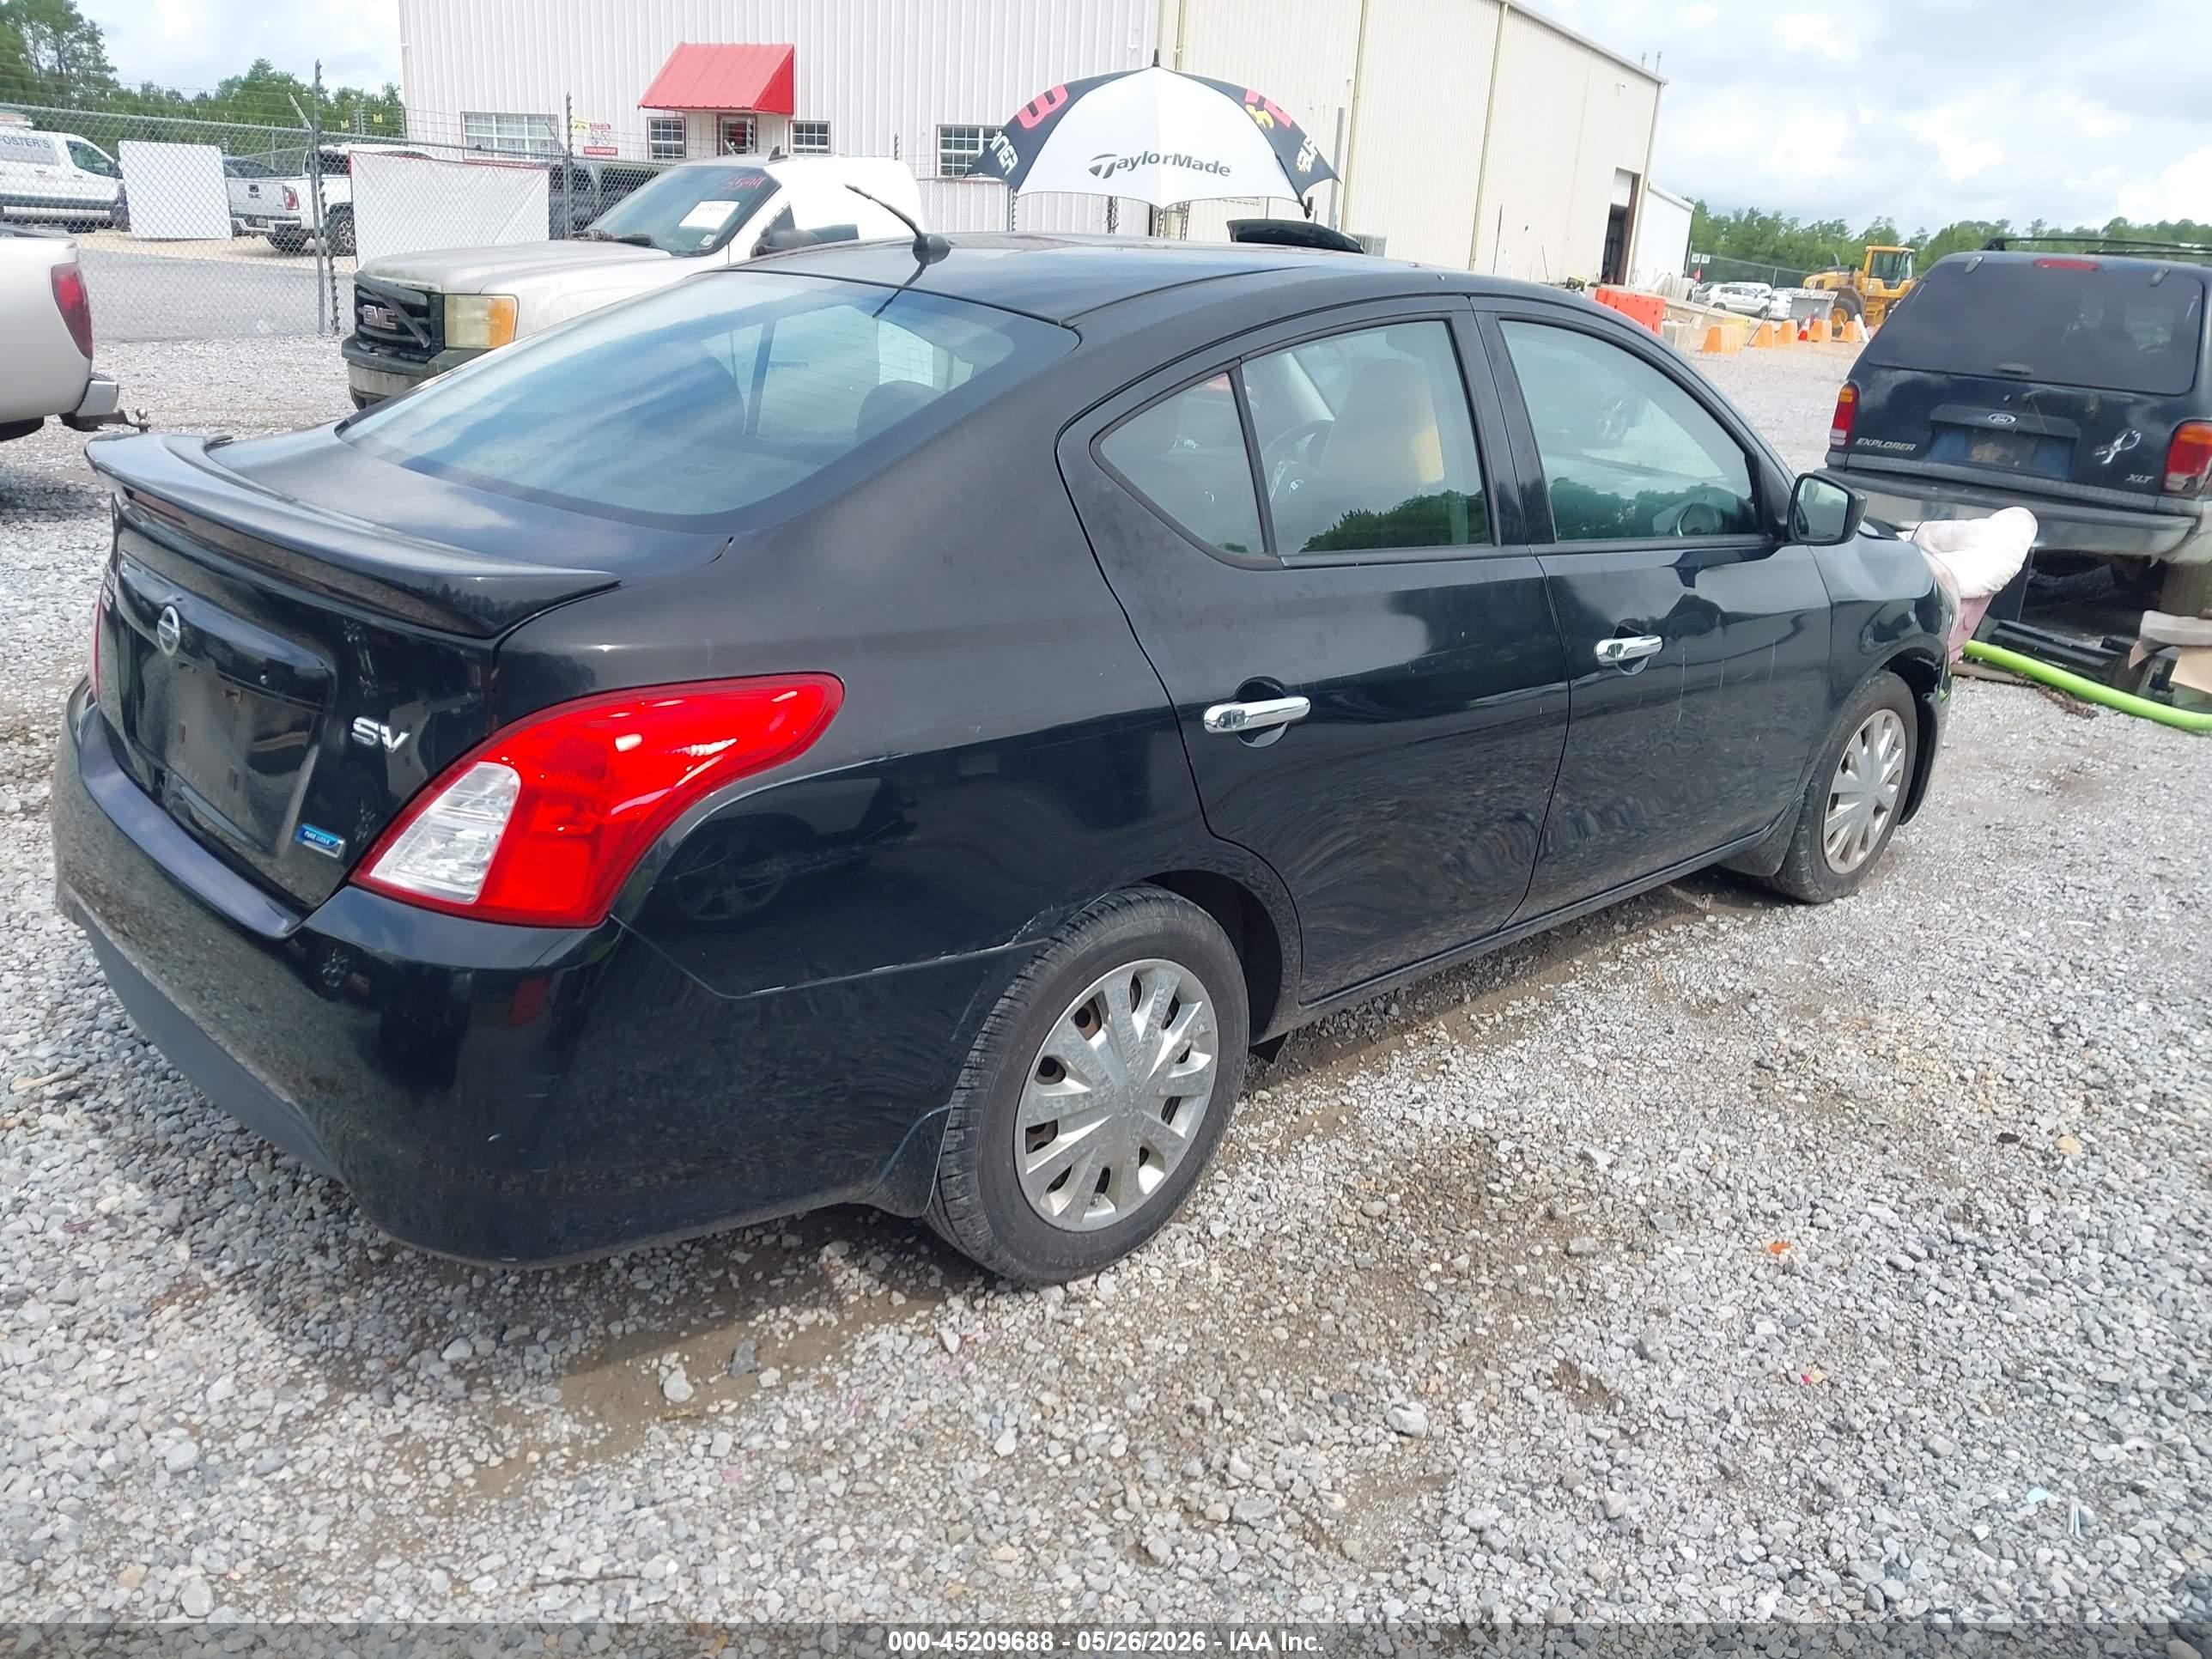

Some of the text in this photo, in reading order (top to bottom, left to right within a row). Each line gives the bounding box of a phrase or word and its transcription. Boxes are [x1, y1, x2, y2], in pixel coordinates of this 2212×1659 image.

[1088, 150, 1231, 179] TaylorMade
[362, 304, 398, 330] GMC
[1856, 437, 1917, 451] EXPLORER
[2125, 473, 2154, 484] XLT
[351, 716, 410, 751] SV
